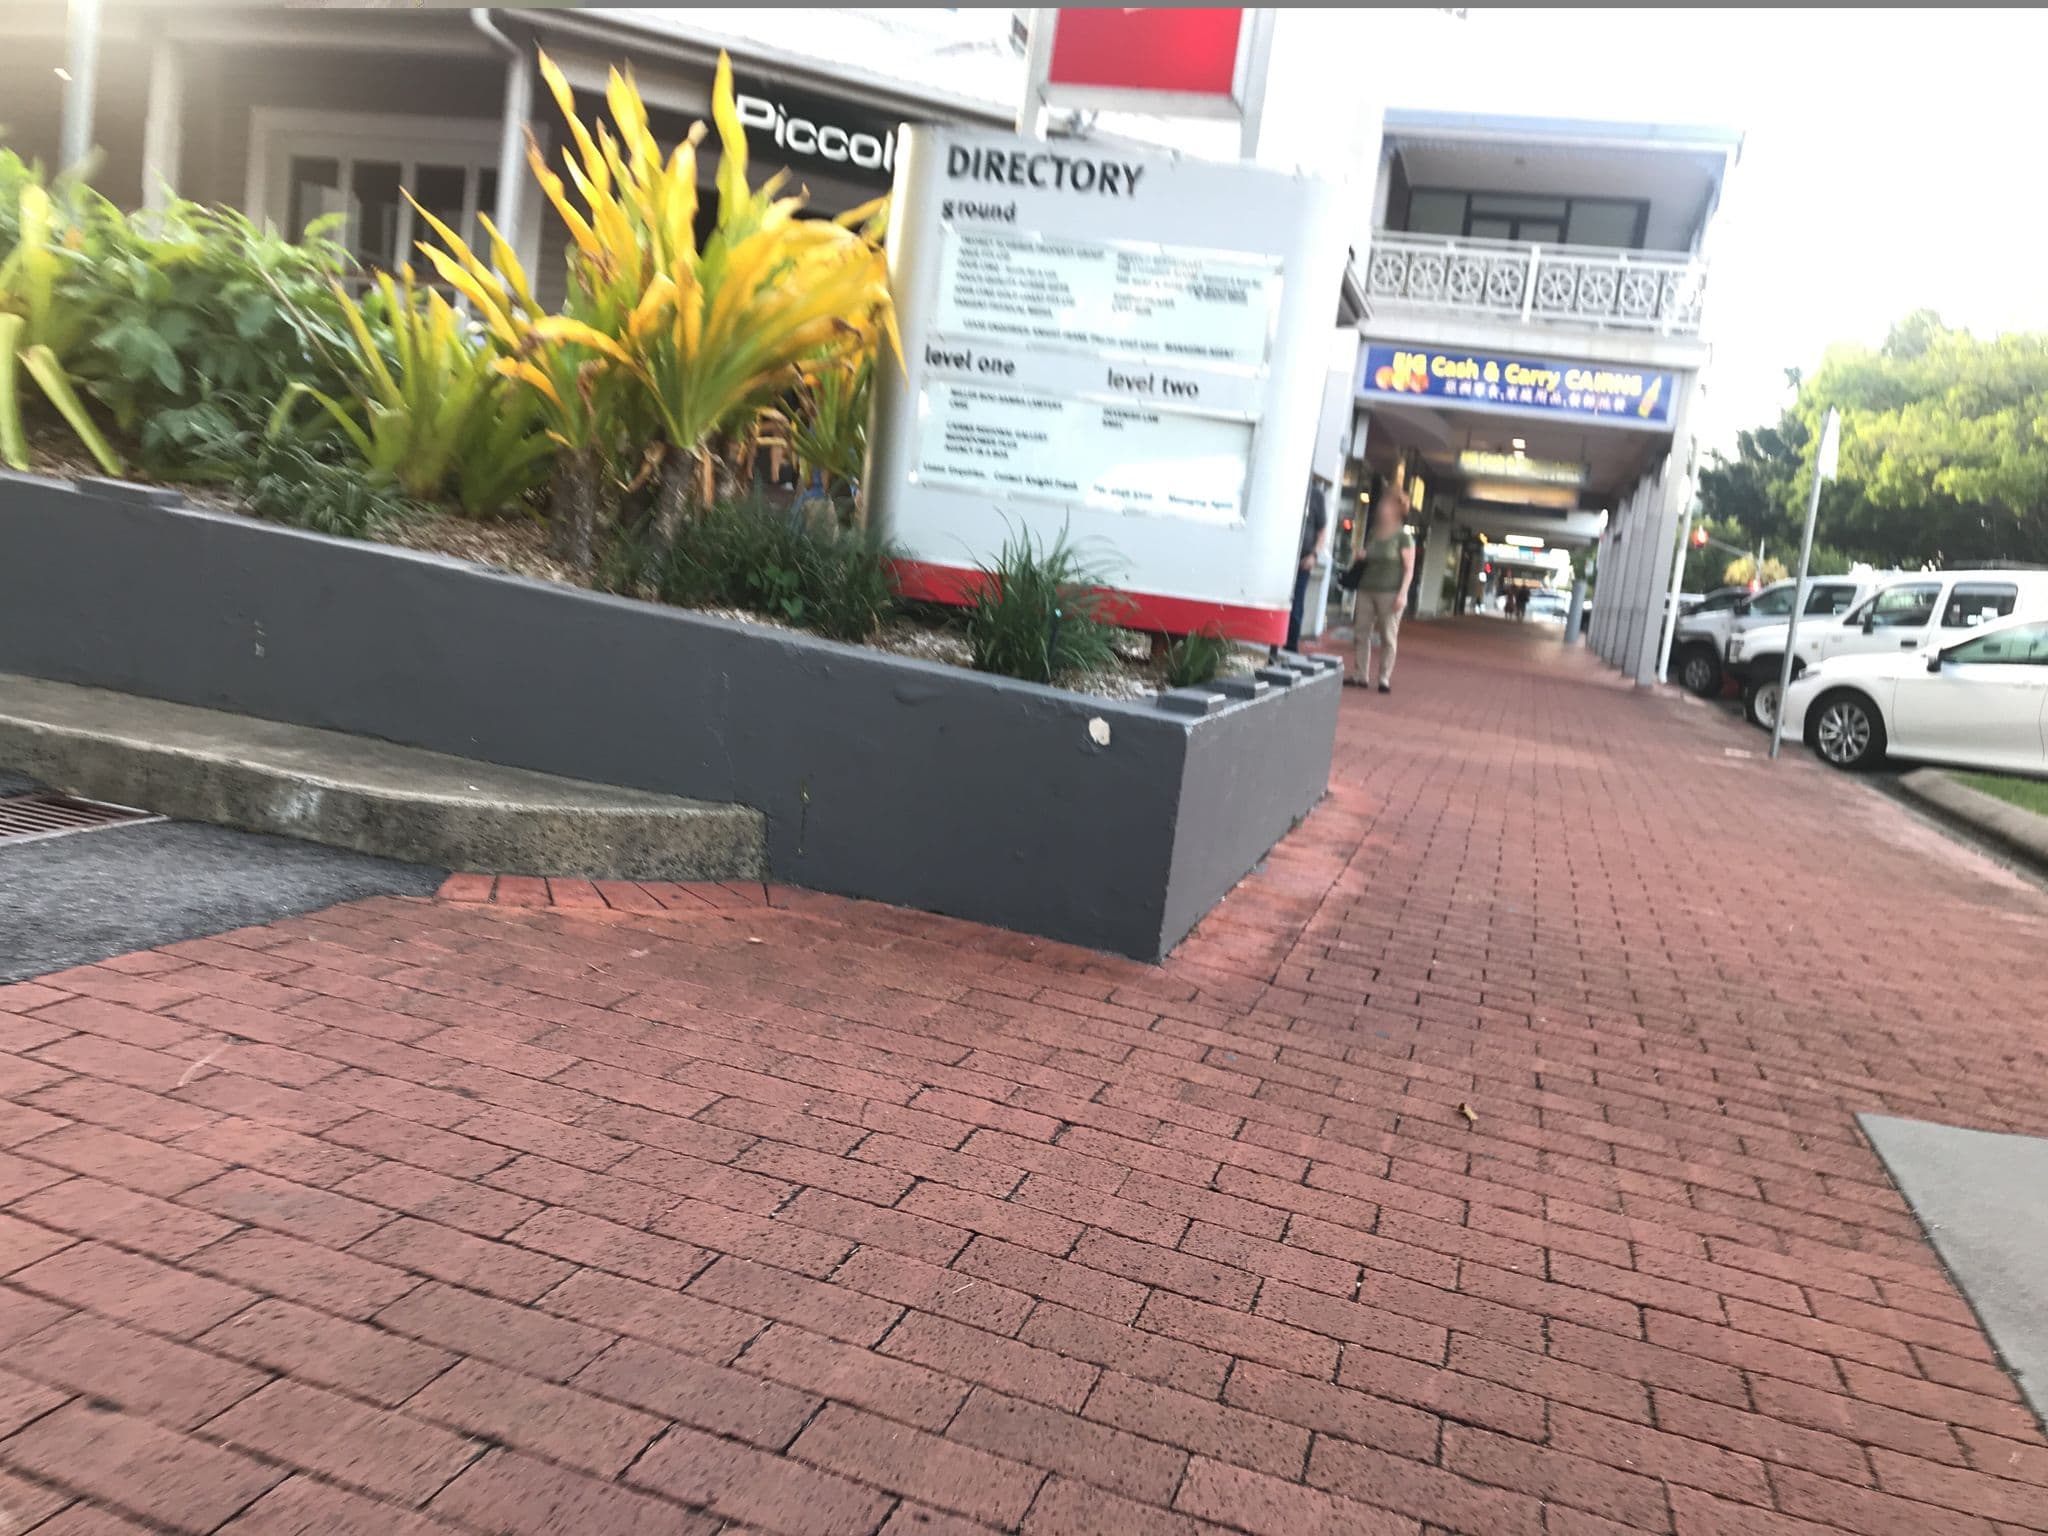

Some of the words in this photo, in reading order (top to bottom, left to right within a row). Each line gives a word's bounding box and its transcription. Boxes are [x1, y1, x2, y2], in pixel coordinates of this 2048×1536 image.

[736, 94, 896, 173] Piccol
[947, 144, 1145, 198] DIRECTORY
[941, 199, 1016, 222] ground
[924, 344, 972, 371] level
[978, 355, 1016, 377] one
[1431, 355, 1479, 380] Cash
[1504, 363, 1561, 392] Carry
[1107, 367, 1155, 394] level
[1162, 374, 1200, 399] two
